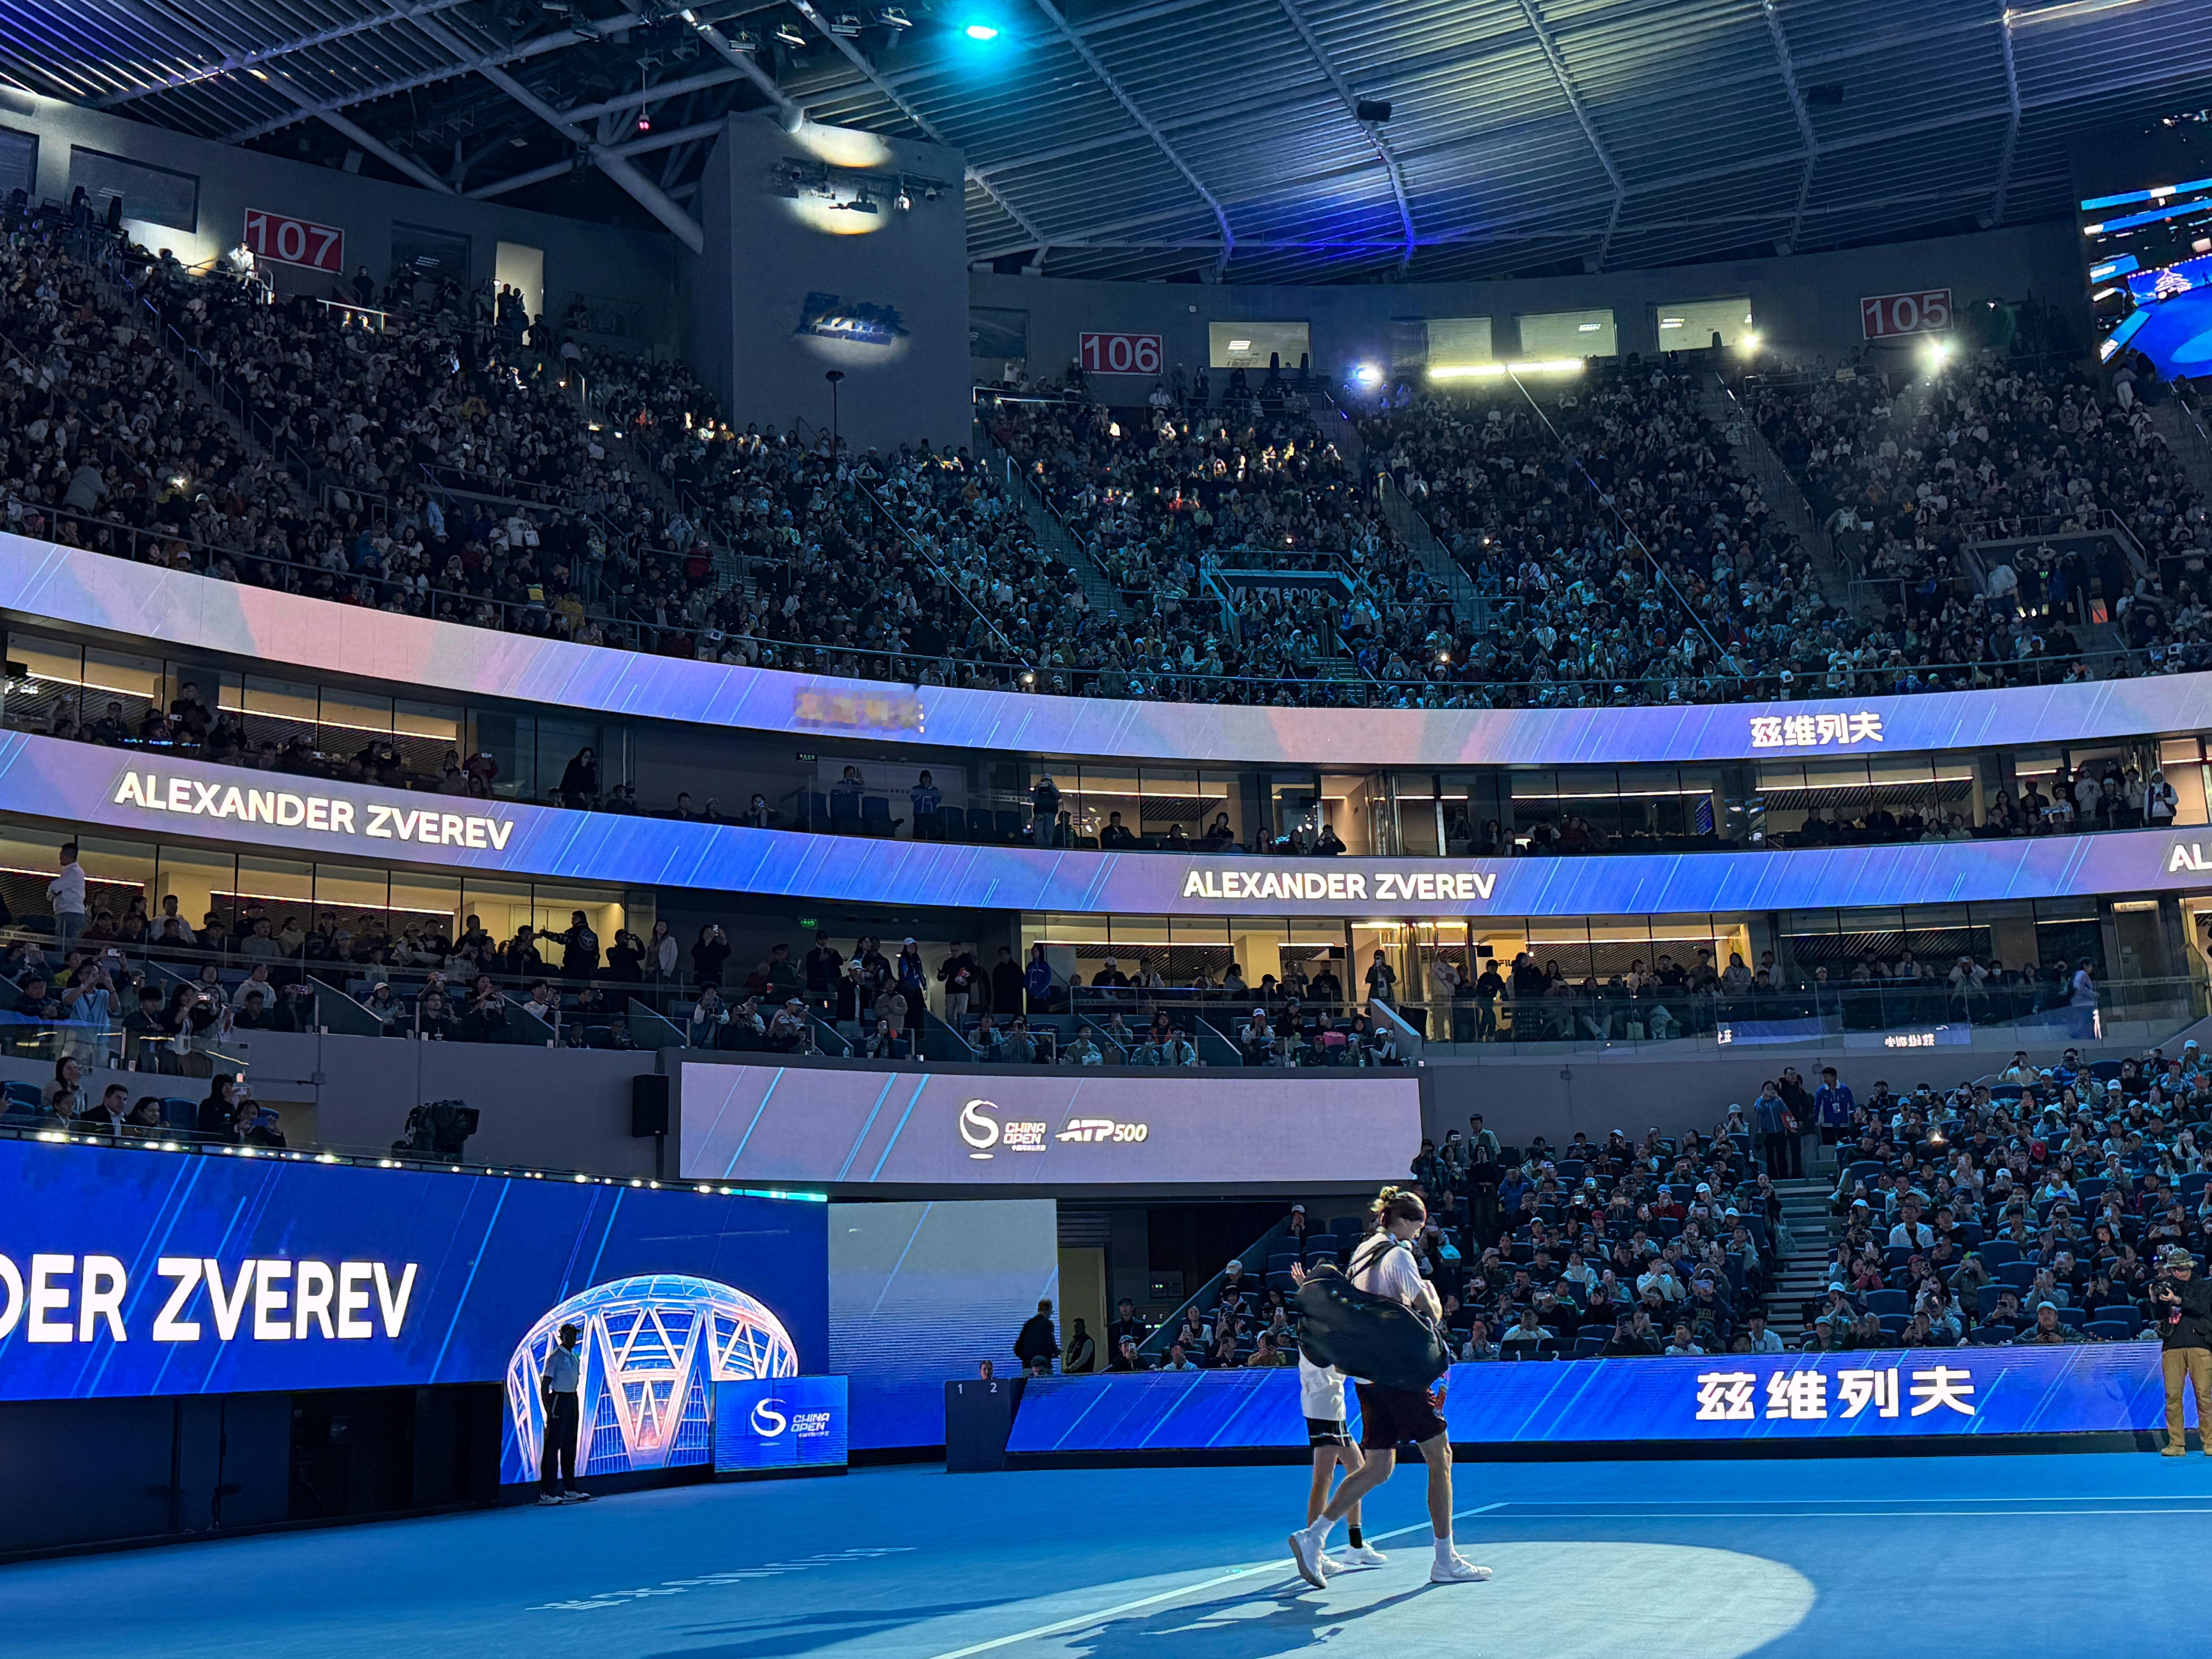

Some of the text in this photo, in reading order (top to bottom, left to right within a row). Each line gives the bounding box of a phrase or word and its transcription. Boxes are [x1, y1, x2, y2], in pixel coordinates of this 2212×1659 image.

[249, 215, 338, 266] 107
[1866, 293, 1948, 334] 105
[1085, 335, 1159, 372] 106
[1750, 711, 1883, 747] 兹维列夫
[114, 772, 514, 850] ALEXANDER ZVEREV
[1183, 871, 1497, 900] ALEXANDER ZVEREV
[1003, 1133, 1041, 1144] OPEN
[1005, 1122, 1046, 1133] CHINA
[153, 1257, 417, 1341] ZVEREV
[958, 1382, 997, 1394] 1 2
[1696, 1365, 1975, 1420] 兹维列夫
[790, 1422, 825, 1432] OPEN
[793, 1412, 830, 1424] CHINA
